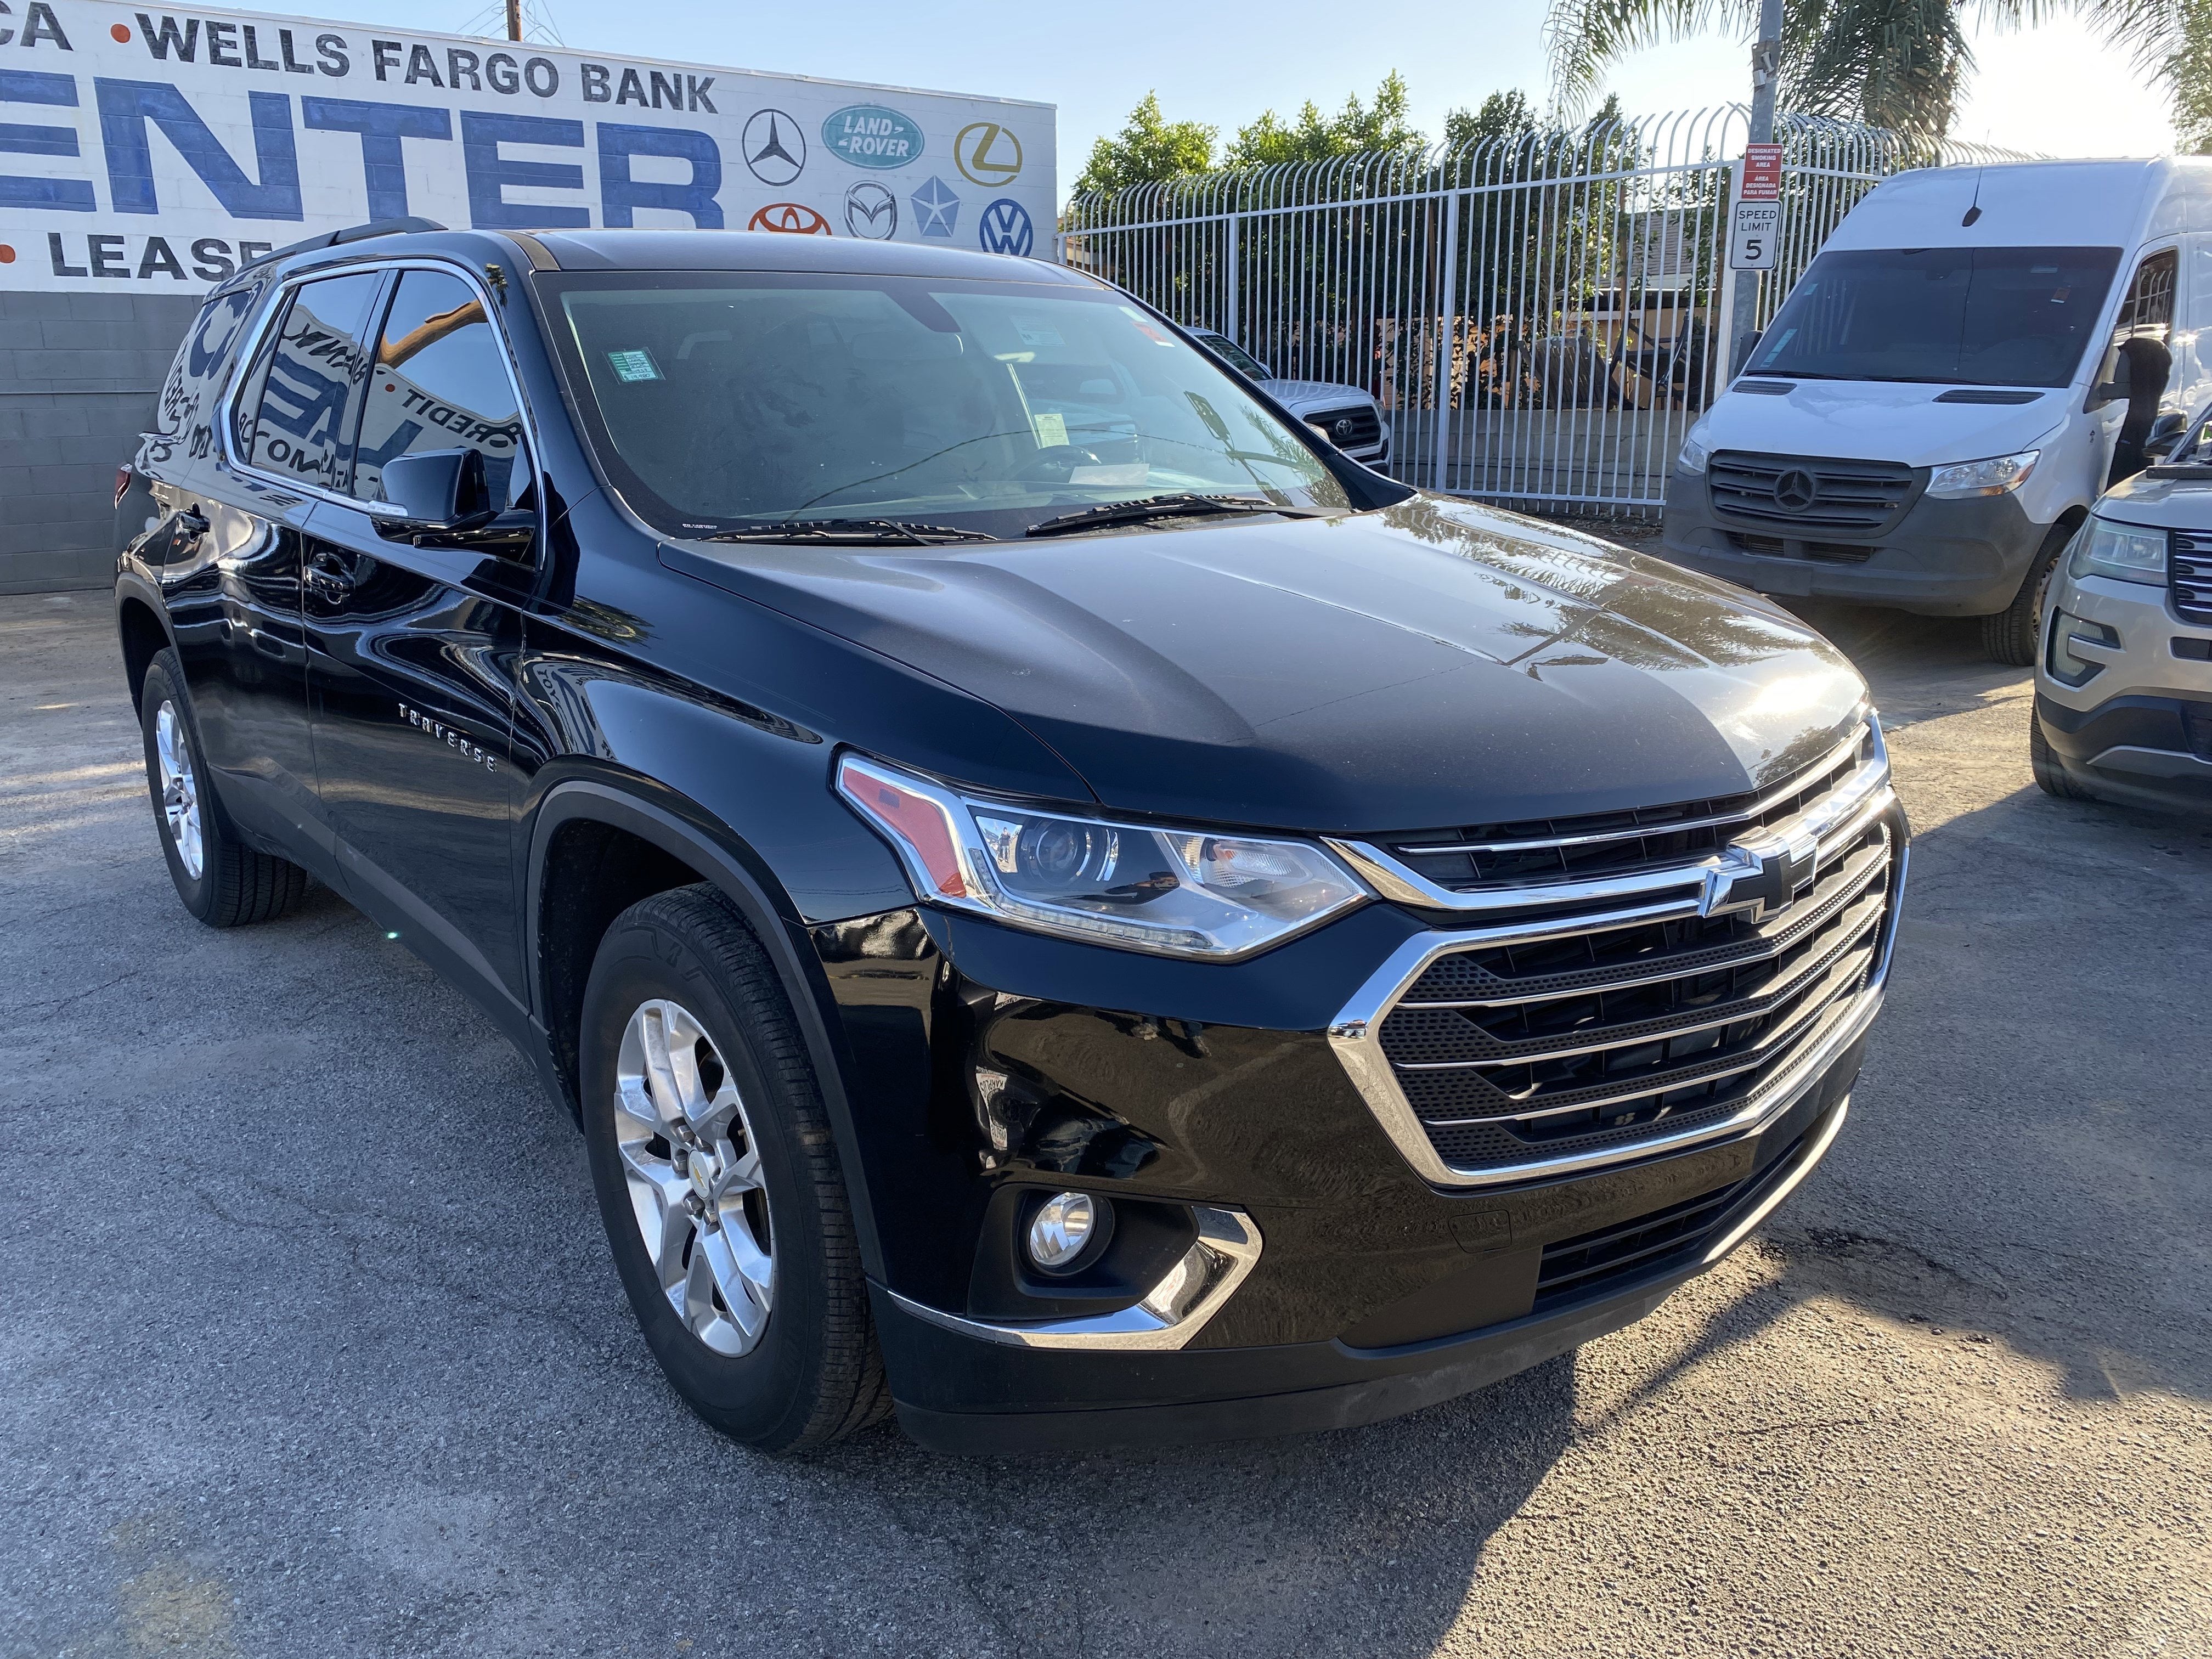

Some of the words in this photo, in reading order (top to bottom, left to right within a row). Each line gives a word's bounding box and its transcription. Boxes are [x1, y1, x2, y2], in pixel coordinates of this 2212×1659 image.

[135, 12, 350, 77] WELLS
[372, 40, 560, 98] FARGO
[580, 63, 718, 114] BANK
[844, 115, 893, 136] LAND
[849, 136, 909, 157] ROVER
[1739, 211, 1777, 219] SPEED
[1741, 222, 1771, 232] LIMIT
[1745, 239, 1762, 260] 5
[398, 703, 498, 772] TRAVERSE
